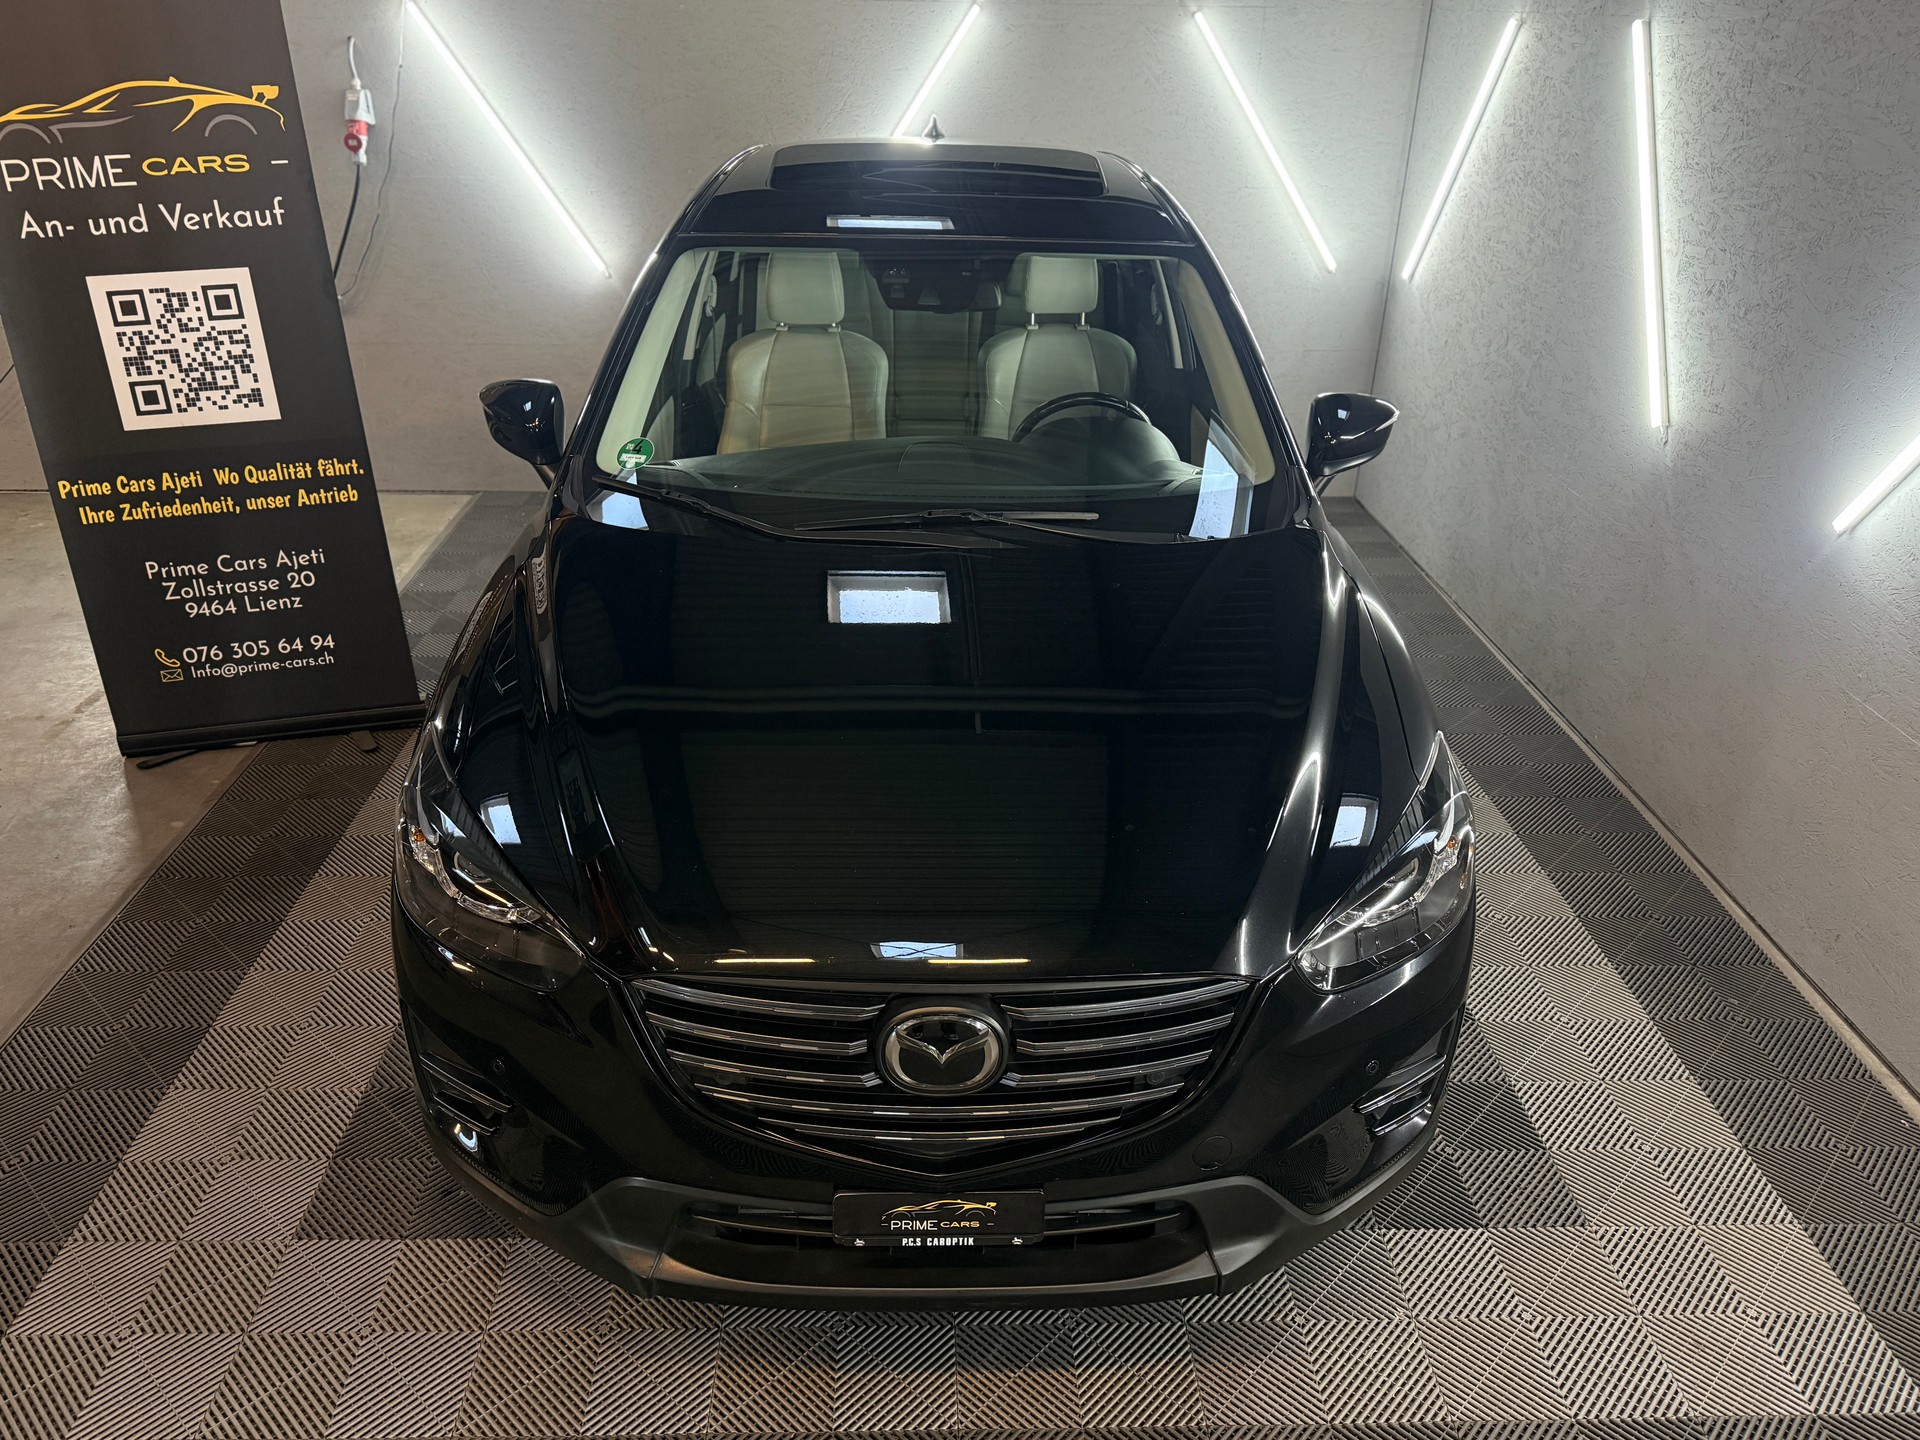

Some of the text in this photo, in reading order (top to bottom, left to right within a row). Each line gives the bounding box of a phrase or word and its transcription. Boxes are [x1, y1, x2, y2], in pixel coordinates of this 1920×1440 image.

[0, 153, 250, 191] PRIME CARS
[20, 196, 285, 239] An- und Verkauf
[632, 439, 643, 454] 4
[57, 458, 365, 499] Prime Cars Ajeti Wo Qualität fährt.
[79, 484, 359, 525] Ihre Zufriedenheit, unser Antrieb
[145, 548, 326, 580] Prime Cars Ajeti
[162, 570, 316, 600] Zollstrasse 20
[185, 595, 303, 619] 9464 Lienz
[182, 634, 336, 664] 076 305 64 94
[191, 652, 335, 678] Info@prime-cars.ch
[890, 1220, 938, 1231] PRIME
[926, 1237, 975, 1247] CAROPTIK
